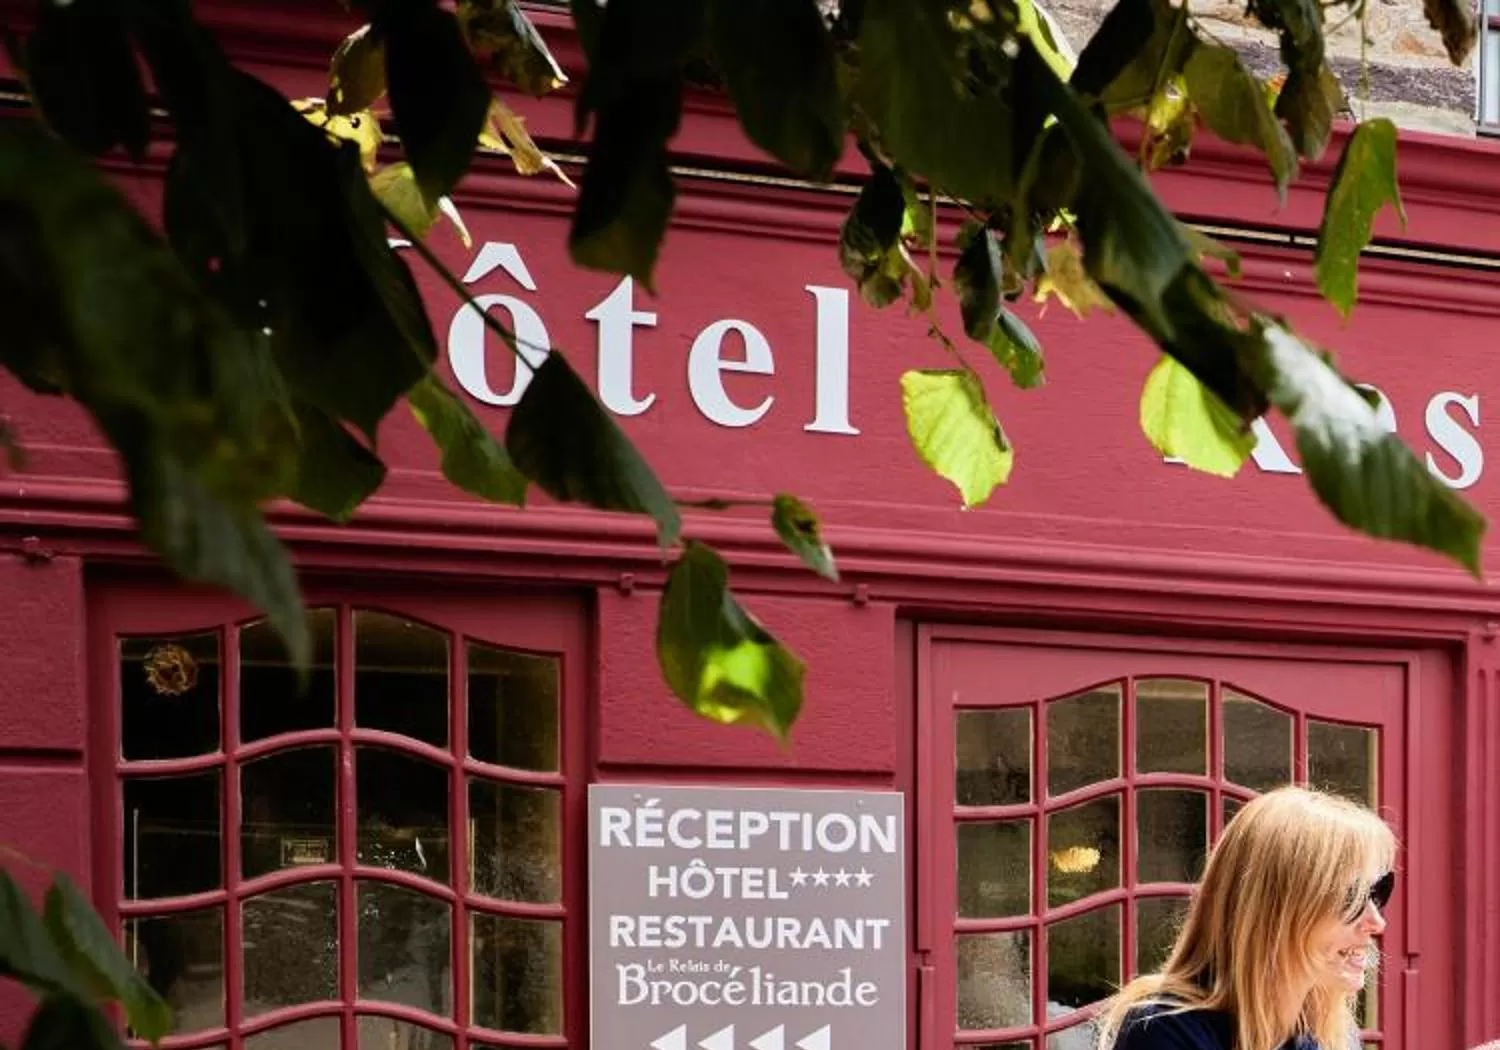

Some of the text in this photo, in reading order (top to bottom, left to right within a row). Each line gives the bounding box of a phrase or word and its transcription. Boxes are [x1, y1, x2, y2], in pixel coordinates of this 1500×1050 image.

[387, 237, 860, 436] ôtel
[599, 798, 897, 853] RÉCEPTION
[609, 915, 891, 950] RESTAURANT
[616, 962, 880, 1007] Brocéliande
[647, 959, 665, 973] Le
[713, 959, 731, 972] de
